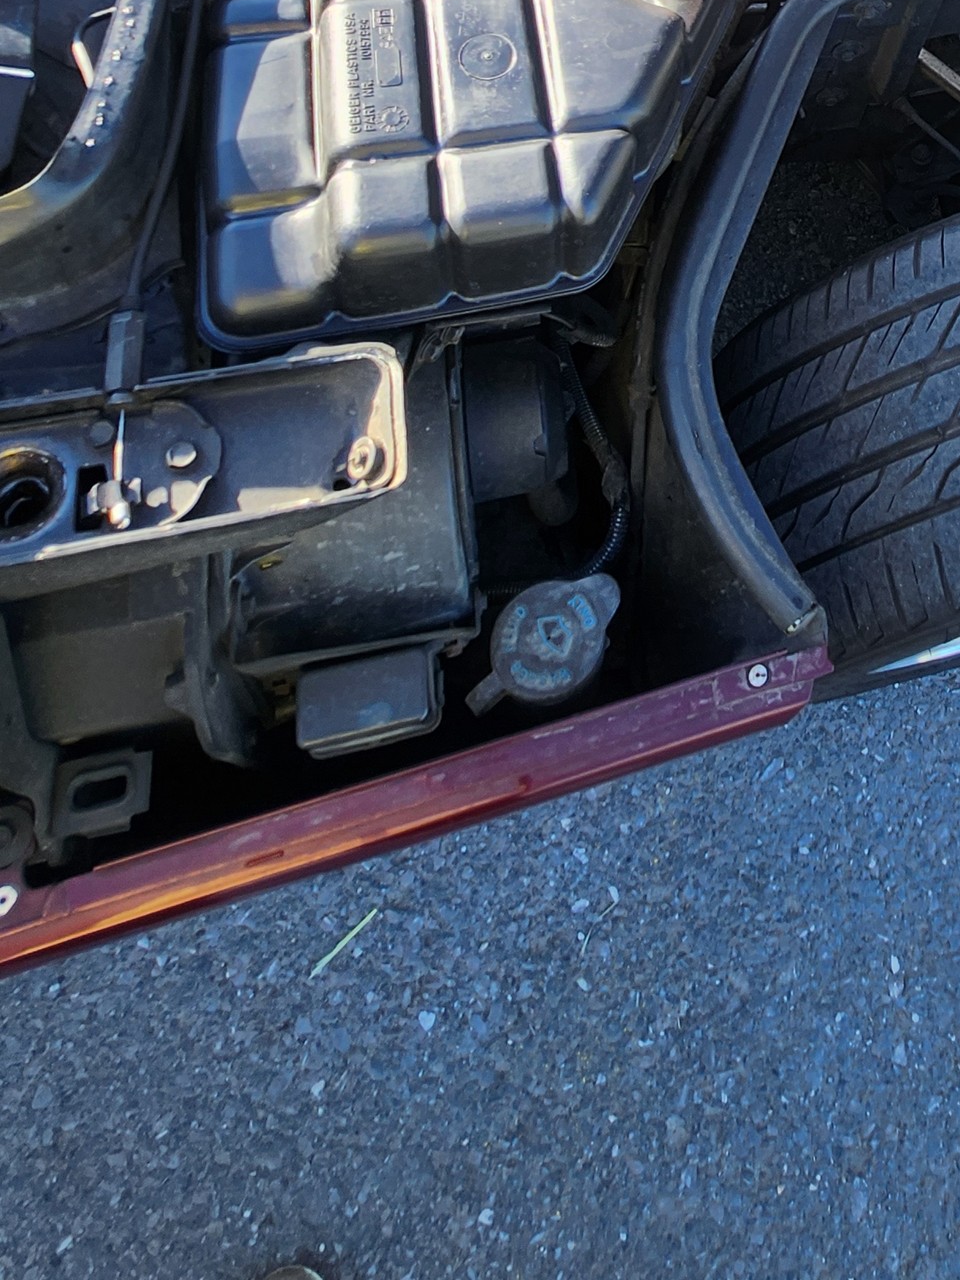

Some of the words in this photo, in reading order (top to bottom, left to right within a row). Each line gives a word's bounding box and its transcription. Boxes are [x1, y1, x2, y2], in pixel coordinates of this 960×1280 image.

[344, 12, 357, 36] USA
[345, 39, 361, 89] PLASTICS
[348, 92, 363, 134] GEIGER
[362, 103, 376, 133] PART
